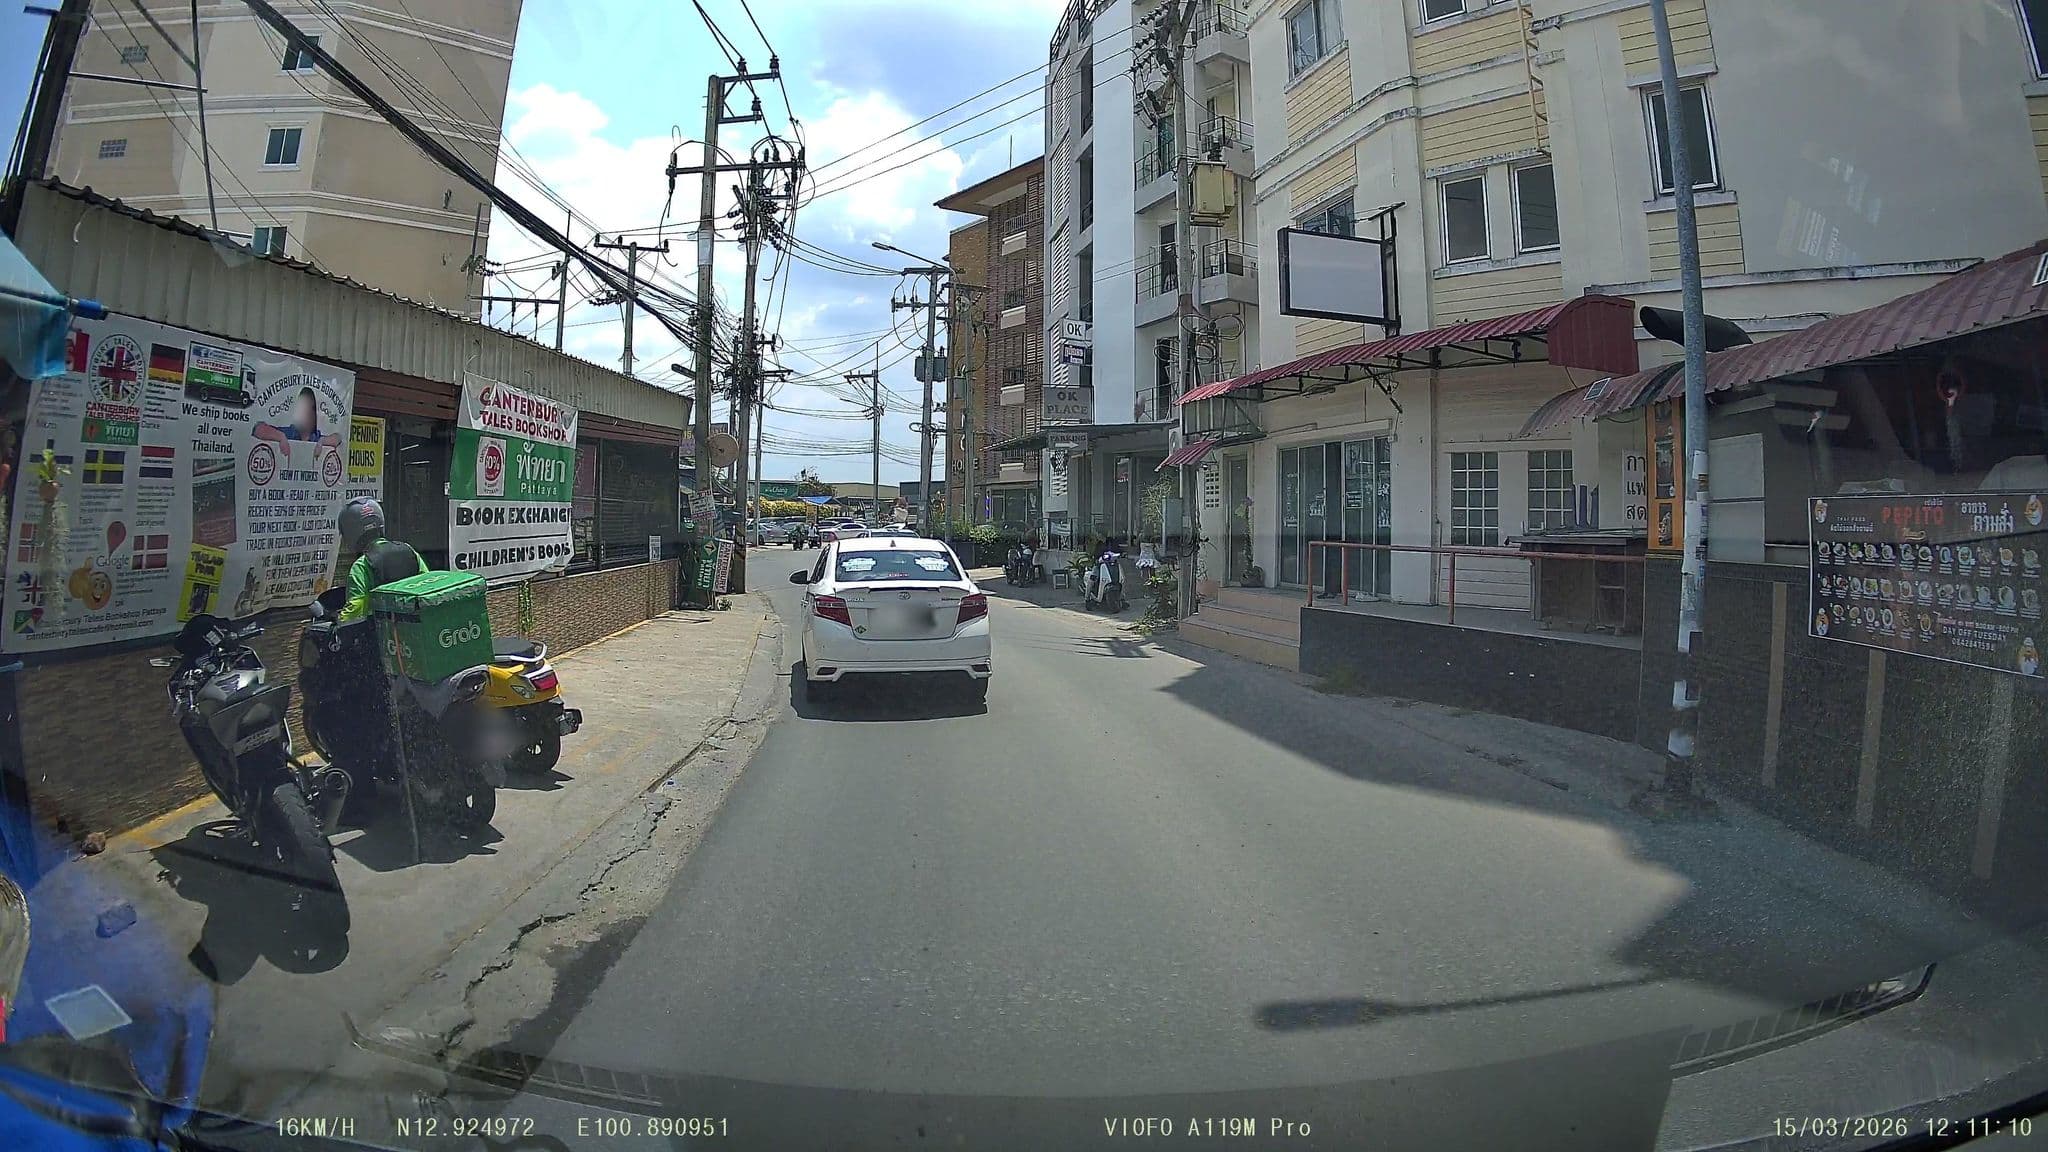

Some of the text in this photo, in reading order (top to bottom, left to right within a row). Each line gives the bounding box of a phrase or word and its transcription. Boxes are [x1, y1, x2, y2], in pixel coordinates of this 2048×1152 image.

[1067, 323, 1082, 336] OK
[257, 374, 301, 407] CANTERBURY
[303, 374, 321, 390] TALES
[1057, 391, 1078, 401] OK
[182, 402, 250, 422] We ship books
[1048, 404, 1088, 415] PLACE
[197, 423, 232, 437] all over
[192, 439, 235, 454] Thailand.
[349, 449, 375, 467] HOURS
[516, 442, 566, 483] พัทยา
[521, 482, 557, 497] Pattaya
[1882, 505, 1944, 526] PEPITO
[455, 546, 535, 570] CHILDREN'S
[438, 620, 482, 648] Grab
